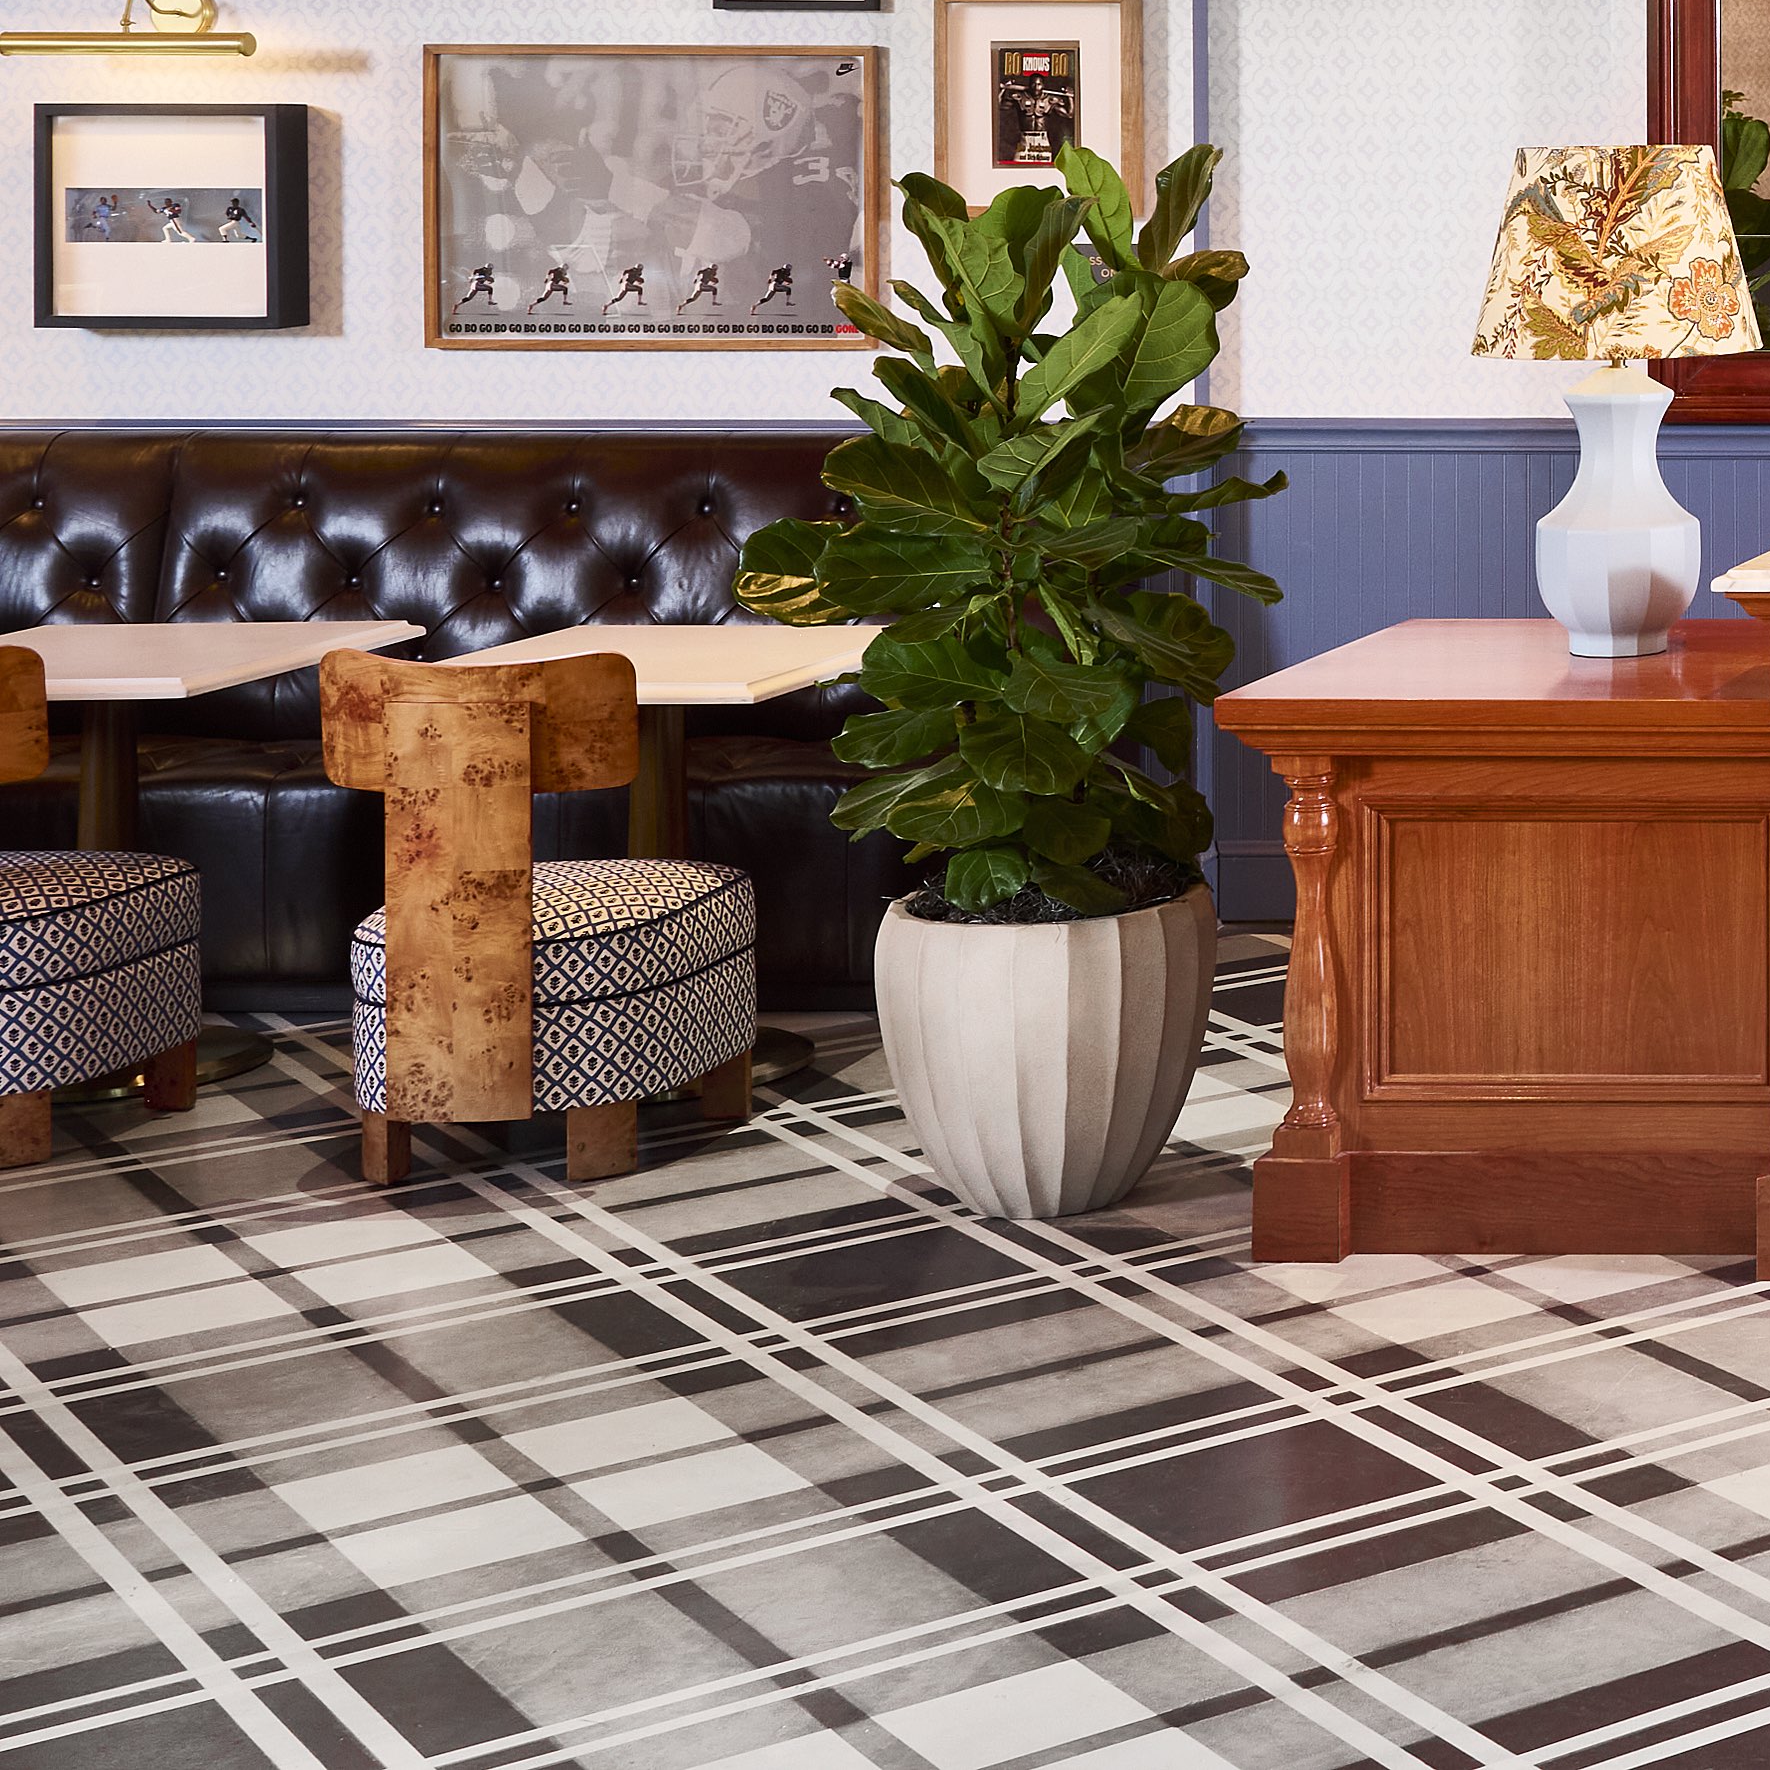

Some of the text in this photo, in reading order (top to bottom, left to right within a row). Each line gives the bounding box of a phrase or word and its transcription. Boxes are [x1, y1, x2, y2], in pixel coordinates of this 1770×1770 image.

[1004, 51, 1069, 77] BO KNOWS BO
[450, 324, 462, 333] GO
[465, 324, 477, 333] BO
[480, 324, 492, 333] GO
[494, 324, 507, 333] BO
[509, 324, 521, 333] GO
[524, 324, 536, 333] BO
[539, 324, 551, 333] GO
[554, 324, 566, 333] BO
[568, 324, 581, 333] GO
[584, 324, 596, 333] BO
[598, 324, 610, 334] GO
[613, 324, 625, 334] BO
[628, 324, 640, 334] GO
[643, 324, 655, 334] BO
[658, 324, 670, 334] GO
[673, 324, 685, 334] BO
[688, 324, 700, 334] GO
[702, 324, 715, 334] BO
[717, 324, 729, 334] GO
[732, 324, 744, 334] BO
[747, 325, 759, 334] GO
[762, 325, 774, 334] BO
[777, 325, 789, 334] GO
[792, 325, 804, 334] BO
[806, 325, 818, 334] GO
[821, 325, 833, 334] BO
